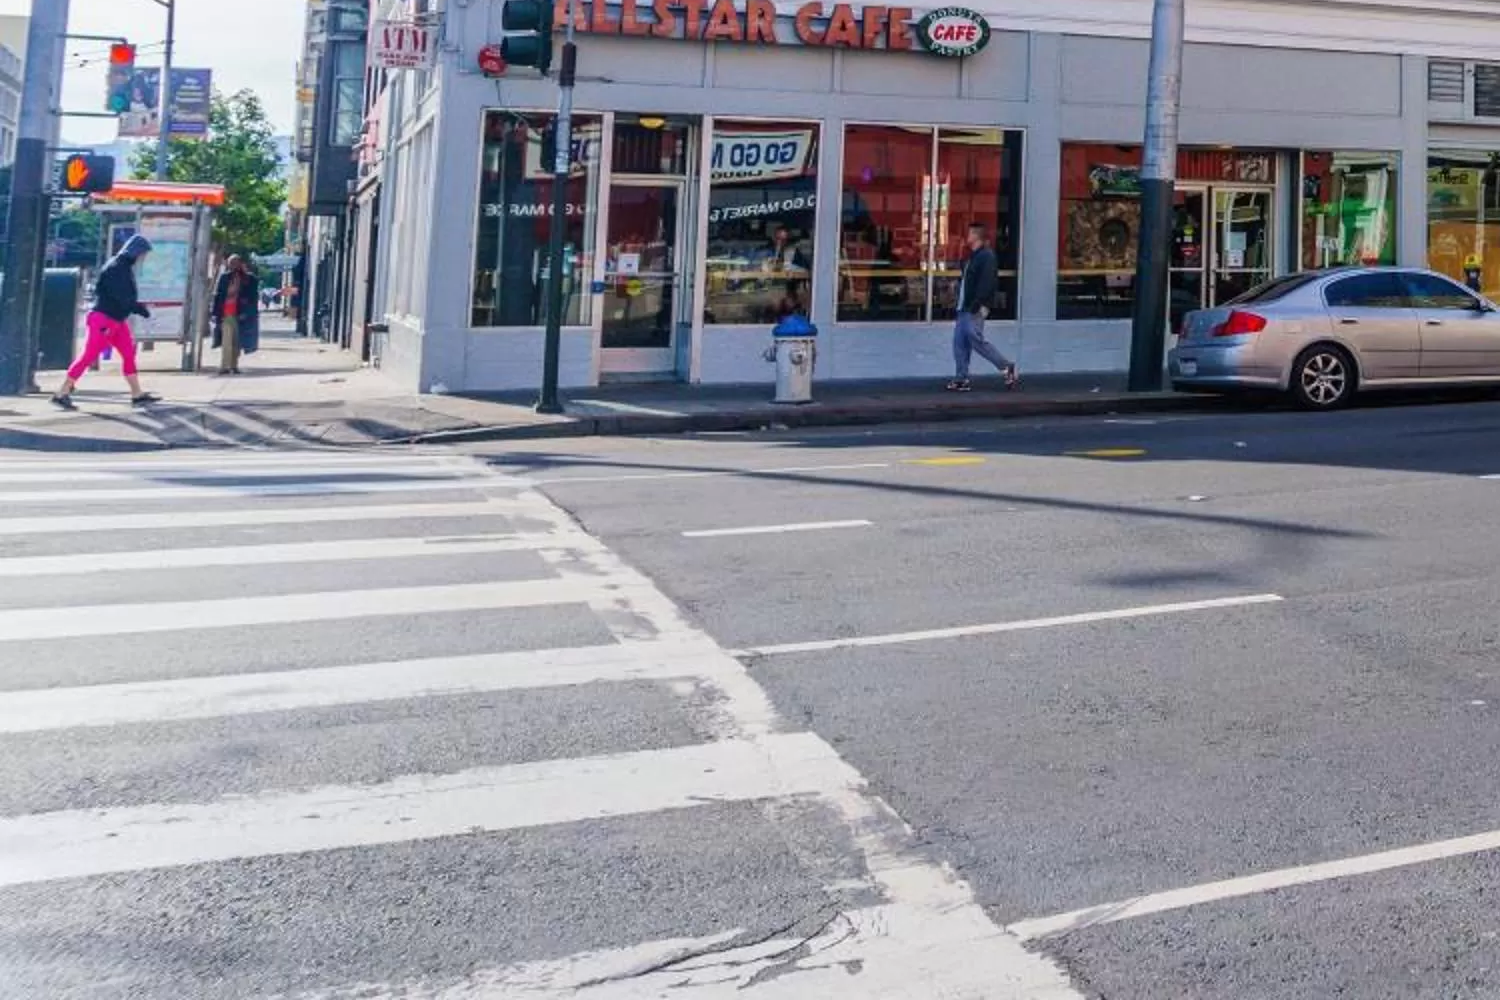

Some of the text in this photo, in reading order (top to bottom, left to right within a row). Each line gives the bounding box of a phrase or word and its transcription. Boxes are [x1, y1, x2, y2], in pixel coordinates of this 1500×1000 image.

[794, 1, 913, 50] CAFE
[933, 23, 977, 41] CAFE
[382, 27, 428, 53] ATM
